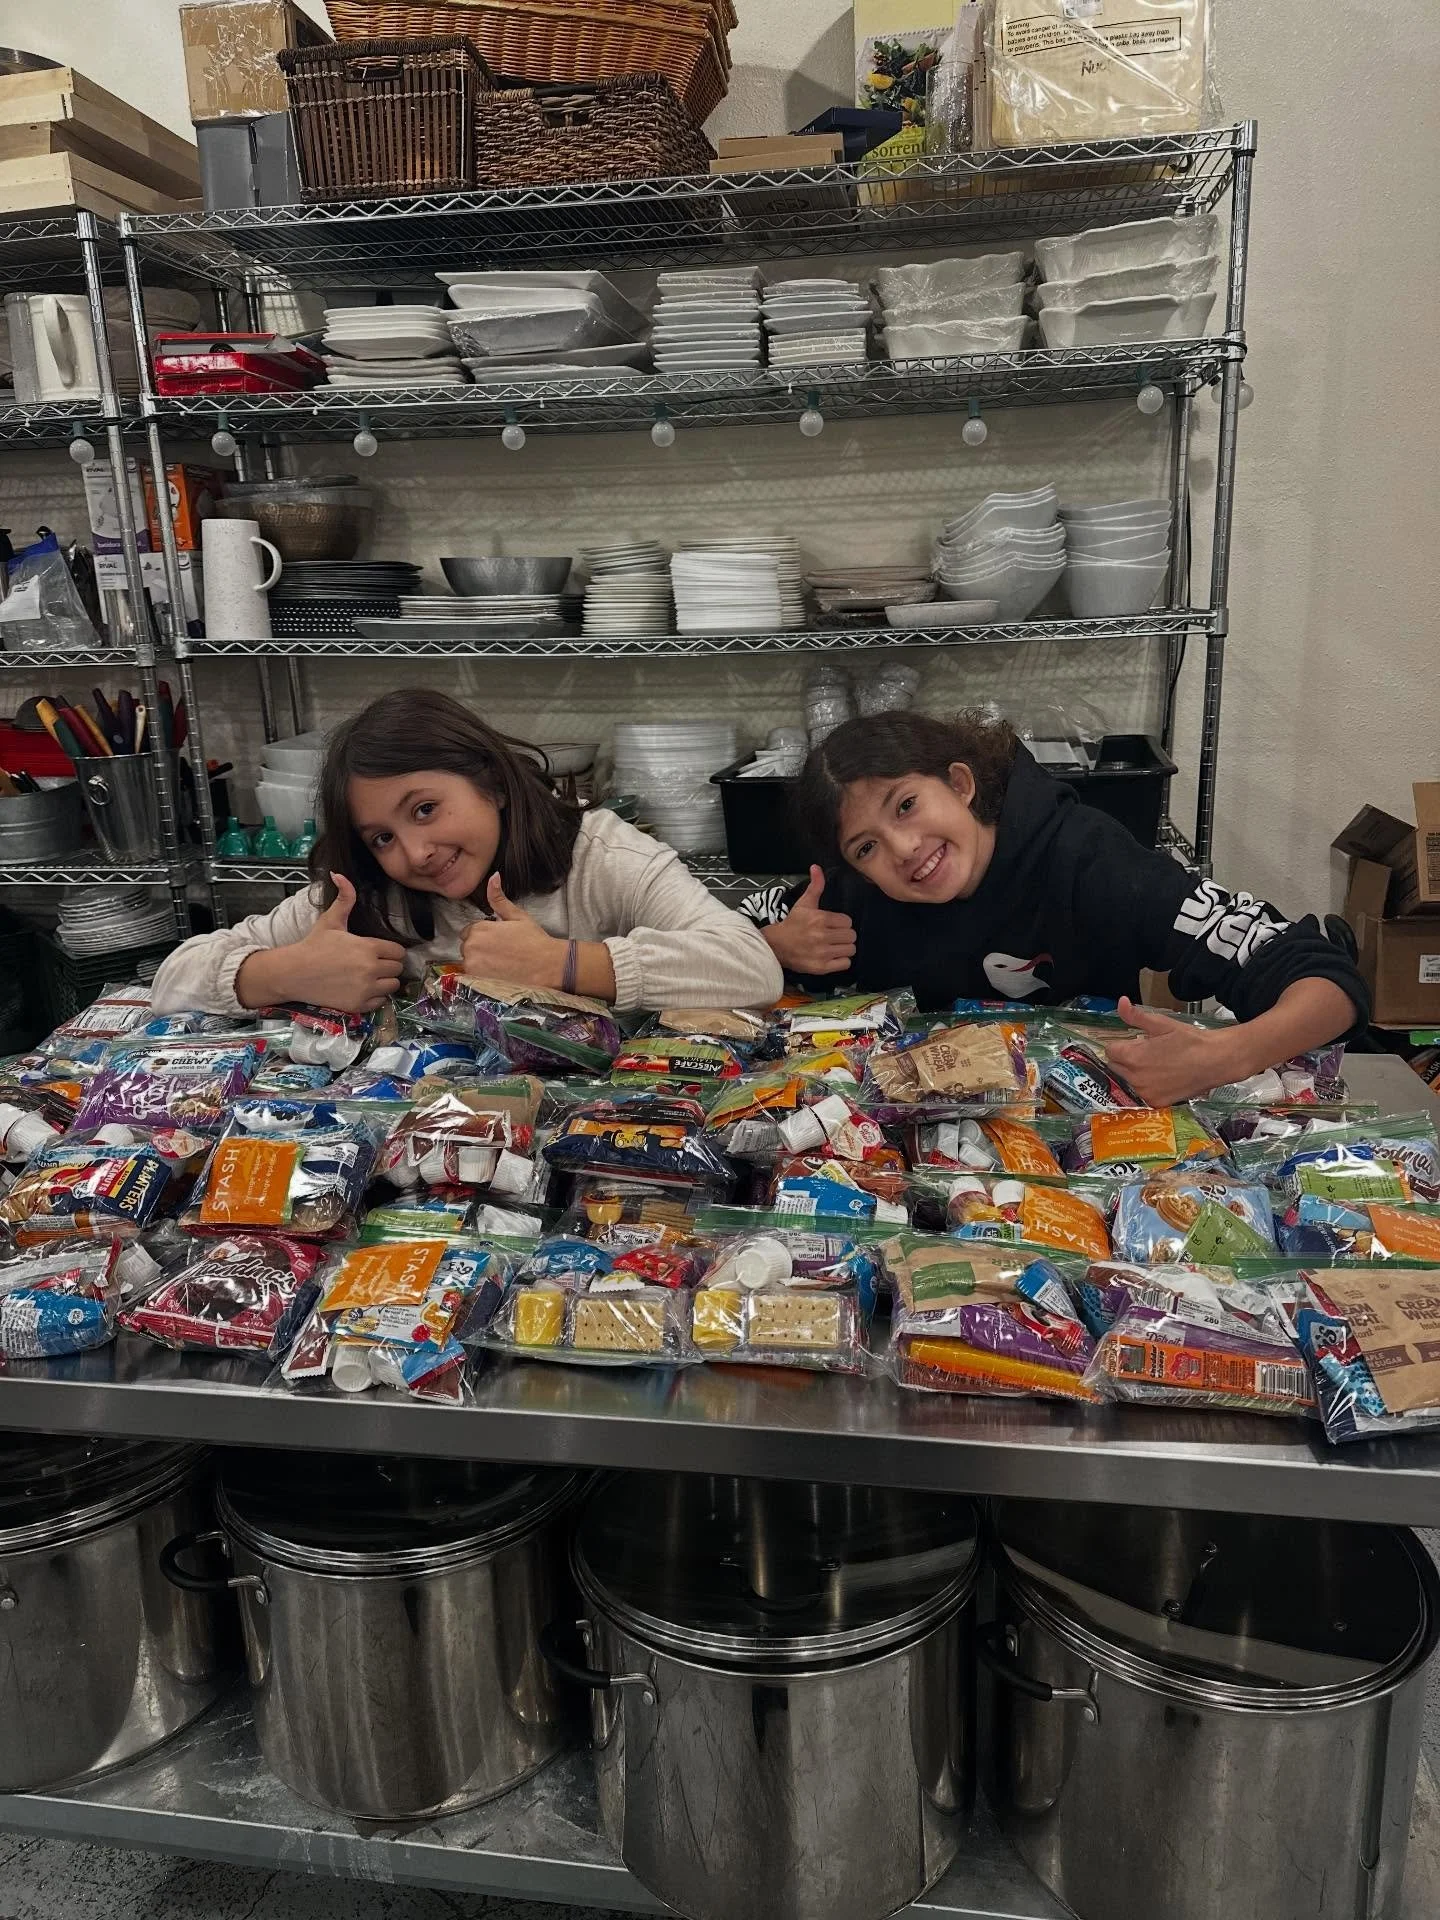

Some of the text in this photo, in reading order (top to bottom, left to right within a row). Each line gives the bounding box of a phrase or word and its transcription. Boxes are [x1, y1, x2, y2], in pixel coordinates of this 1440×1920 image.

[171, 1057, 213, 1066] CHEWY
[929, 1046, 946, 1073] WHEAT
[939, 1043, 957, 1071] CREAM
[1086, 1090, 1110, 1107] SOFT
[1101, 1110, 1160, 1124] STASH
[99, 1158, 125, 1193] PEANUTS
[118, 1158, 160, 1212] PLANTERS
[212, 1148, 241, 1212] STASH
[1036, 1221, 1101, 1255] STASH
[1402, 1309, 1440, 1321] WHE
